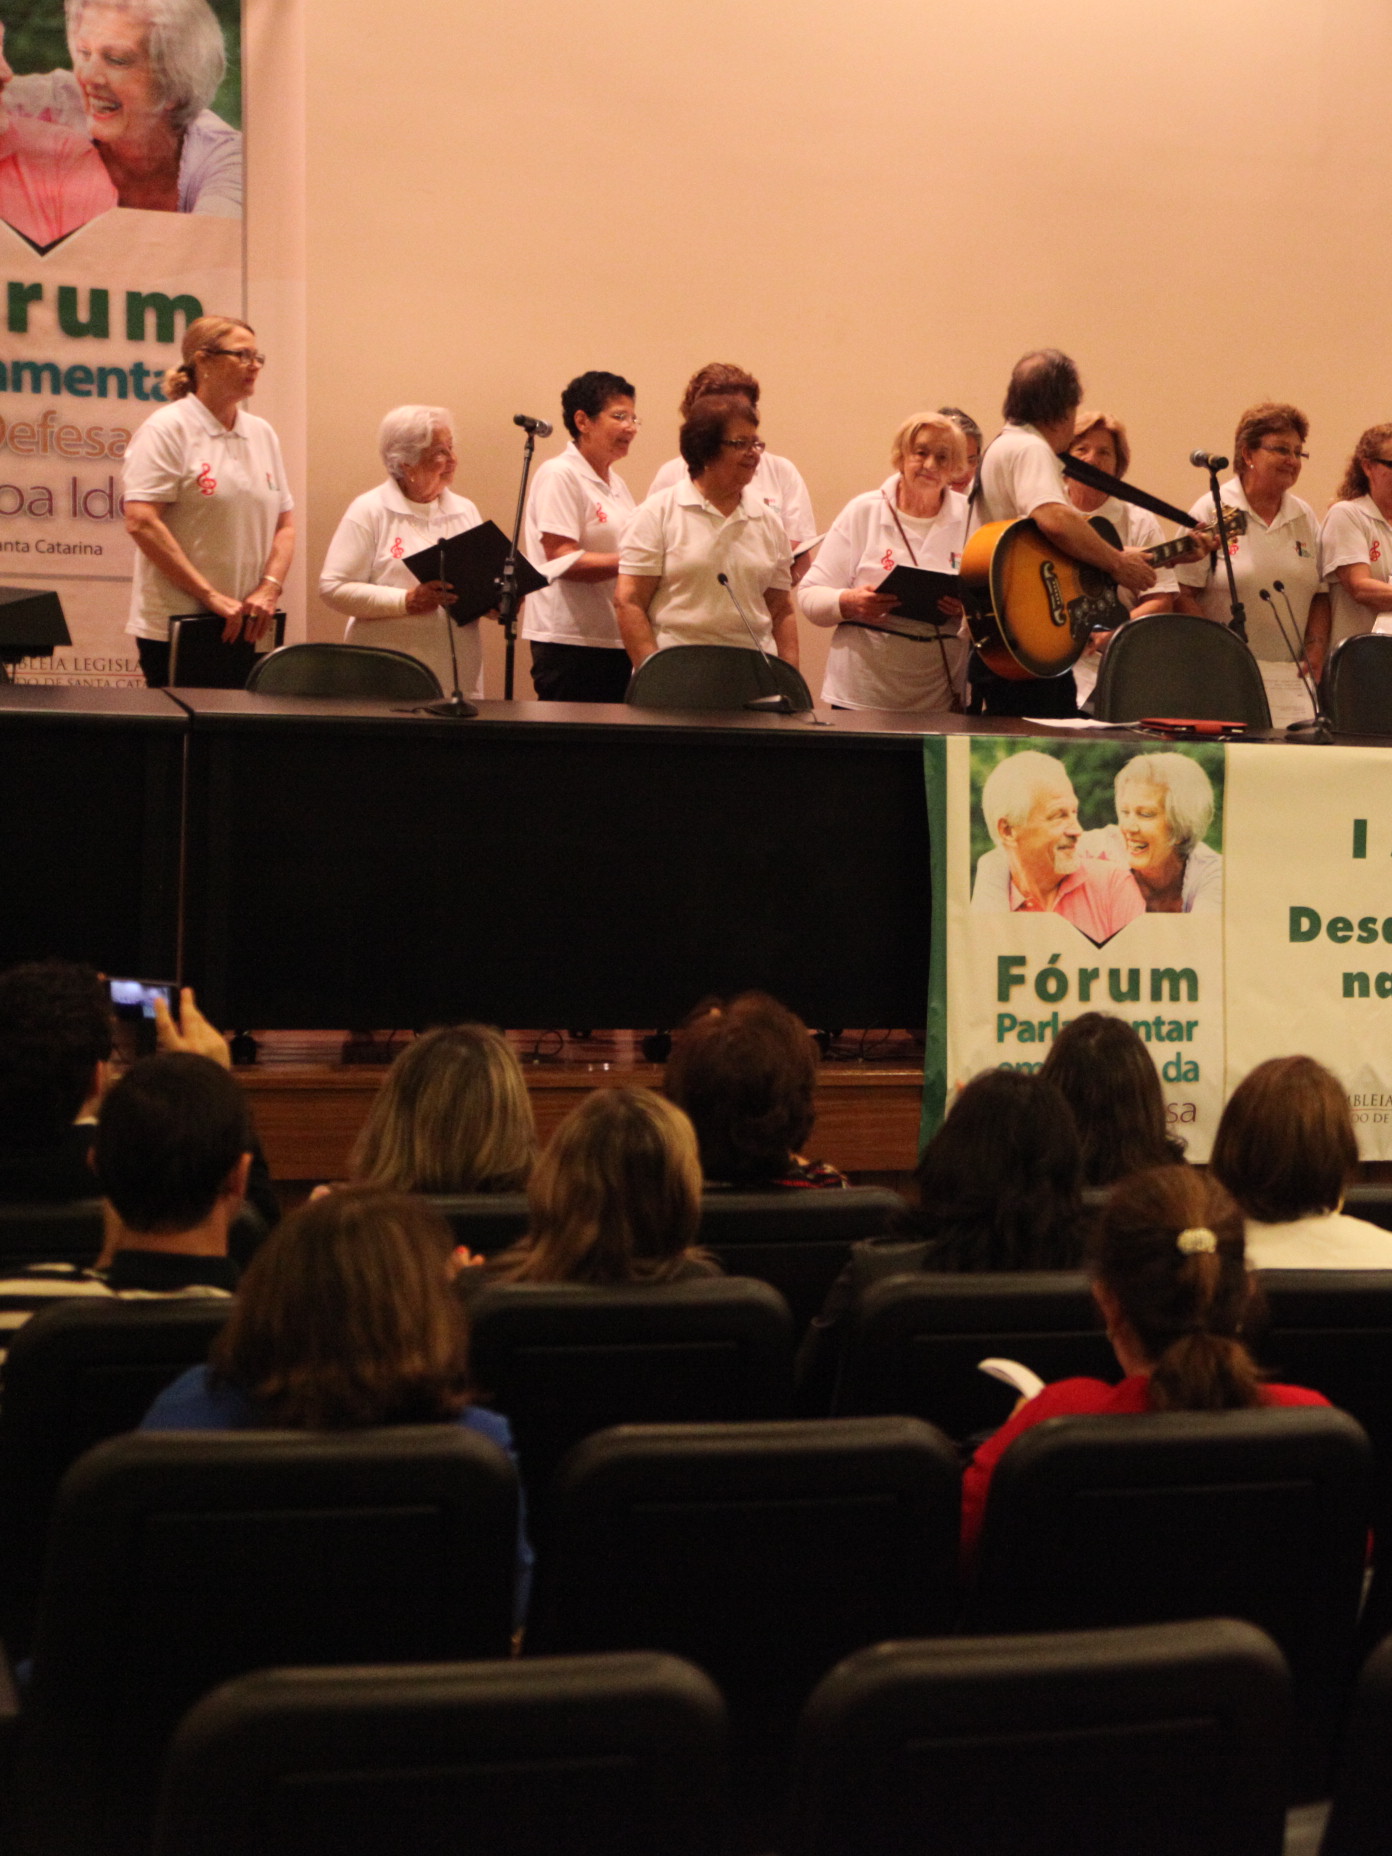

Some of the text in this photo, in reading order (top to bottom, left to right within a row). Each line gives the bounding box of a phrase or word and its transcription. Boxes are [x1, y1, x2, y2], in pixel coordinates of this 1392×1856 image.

[7, 281, 204, 344] rum
[0, 410, 134, 458] efesa
[35, 540, 103, 556] Catarina
[1353, 819, 1367, 859] I
[998, 953, 1199, 1003] Fórum
[997, 1012, 1199, 1043] Parlntar
[1162, 1052, 1200, 1082] da
[1373, 1113, 1389, 1124] DE
